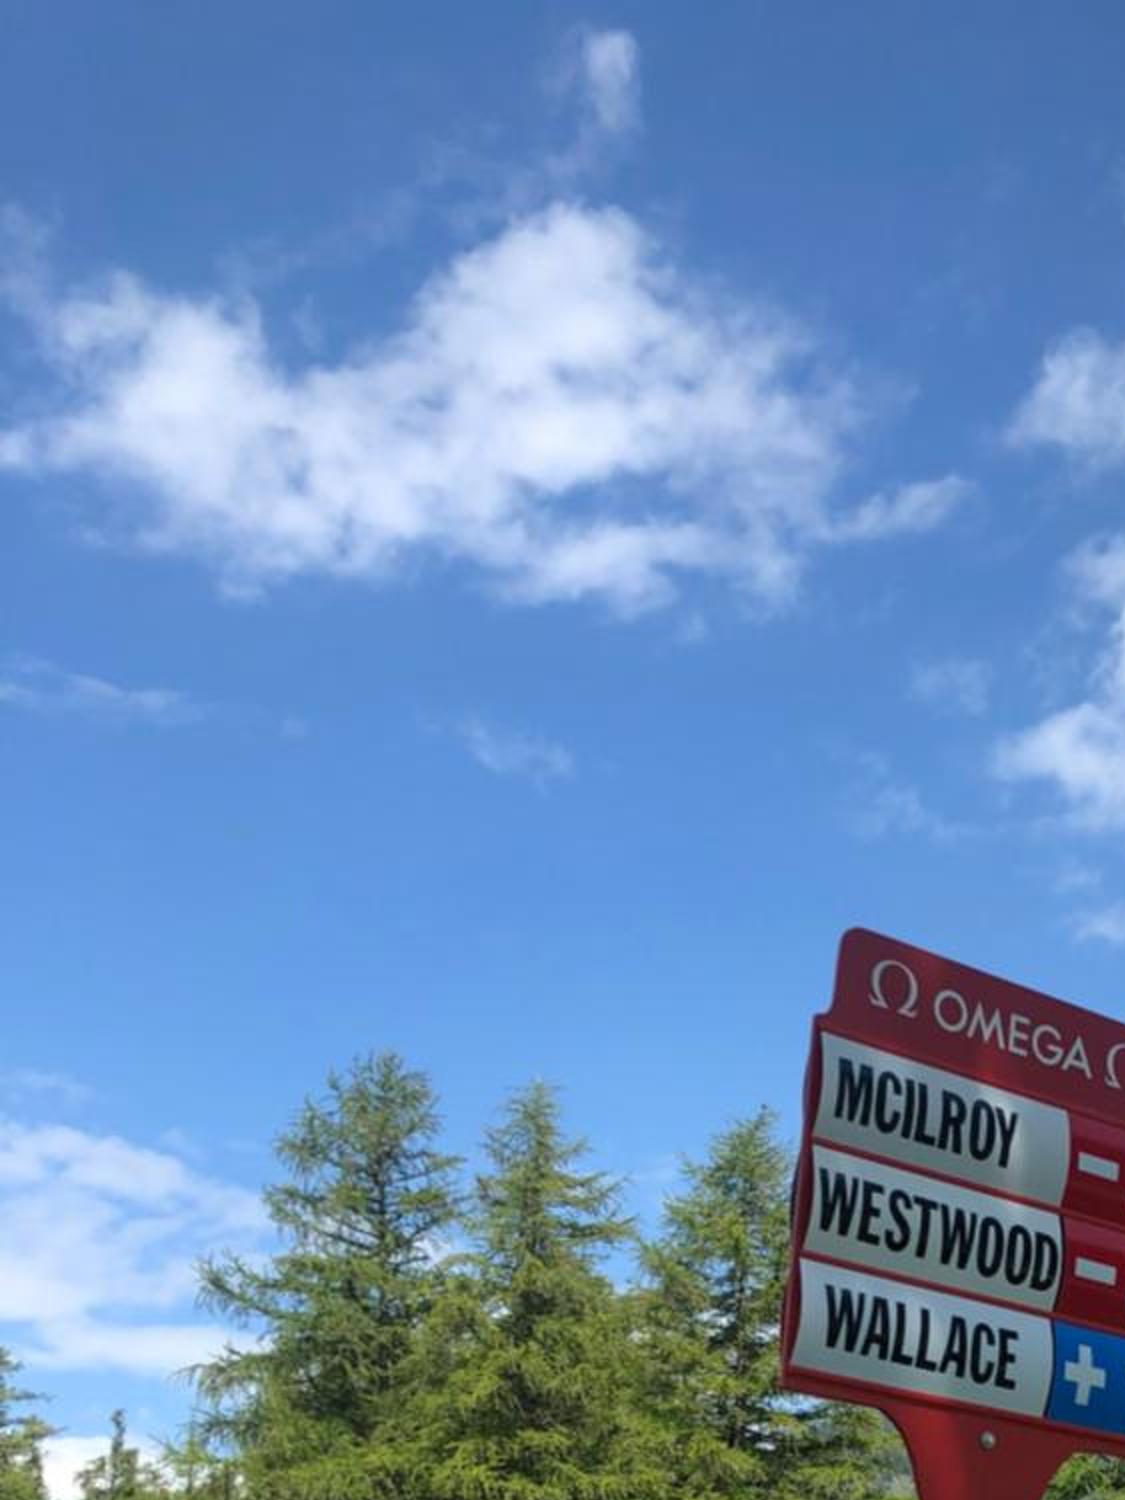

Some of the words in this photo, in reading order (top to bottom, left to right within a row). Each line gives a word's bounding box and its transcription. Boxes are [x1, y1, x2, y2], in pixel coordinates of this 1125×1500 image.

[933, 990, 1093, 1079] OMEGA
[834, 1058, 1018, 1168] MCILROY
[818, 1167, 1060, 1292] WESTWOOD
[824, 1284, 1018, 1389] WALLACE
